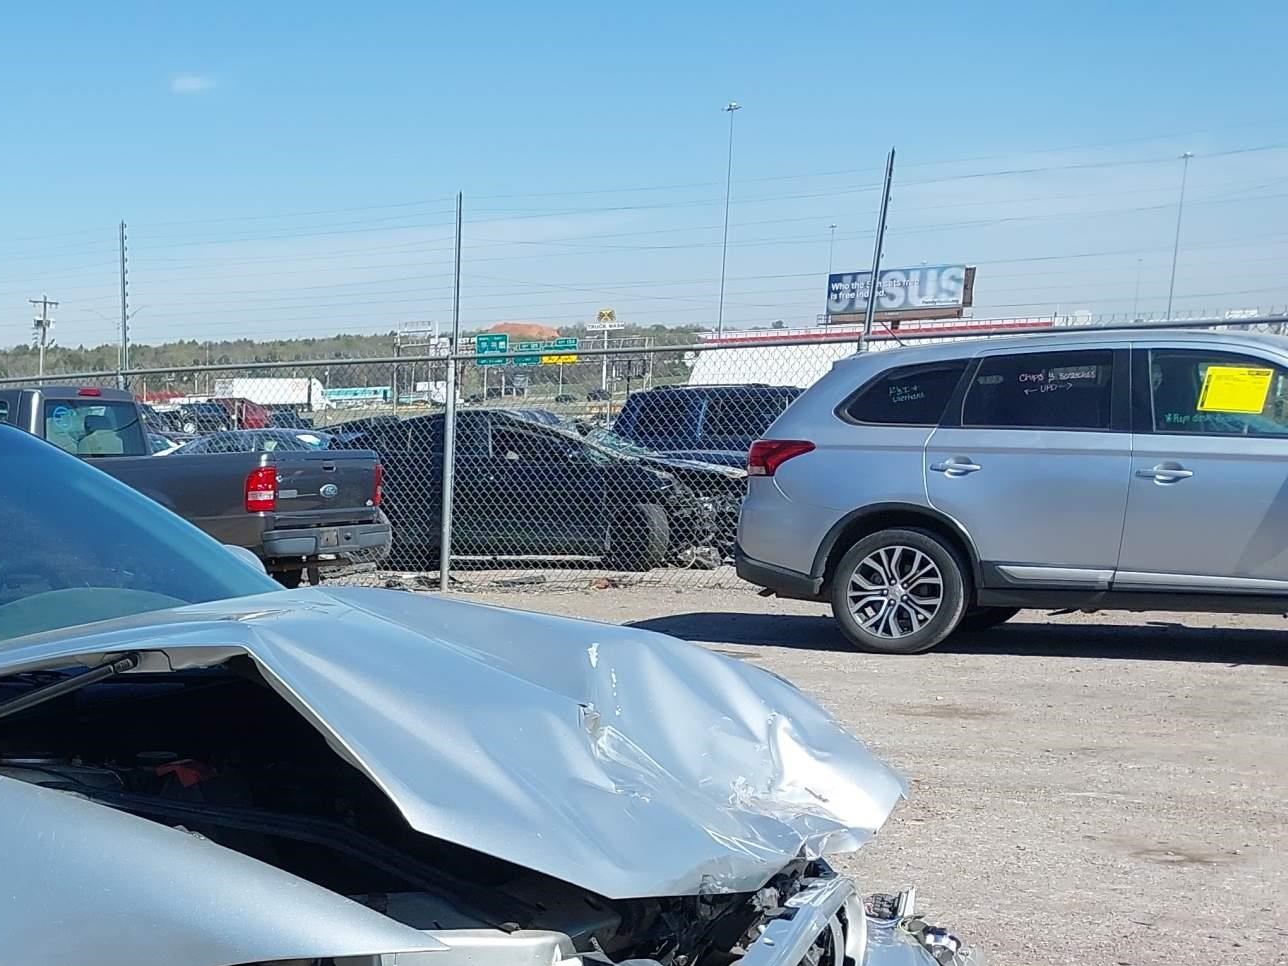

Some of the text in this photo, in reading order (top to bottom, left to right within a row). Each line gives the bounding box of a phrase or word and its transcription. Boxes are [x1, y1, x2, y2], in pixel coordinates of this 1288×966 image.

[827, 267, 962, 312] JESUS
[831, 281, 850, 290] Who
[851, 280, 864, 289] the
[866, 279, 882, 288] Sn
[830, 290, 887, 300] is free inded.
